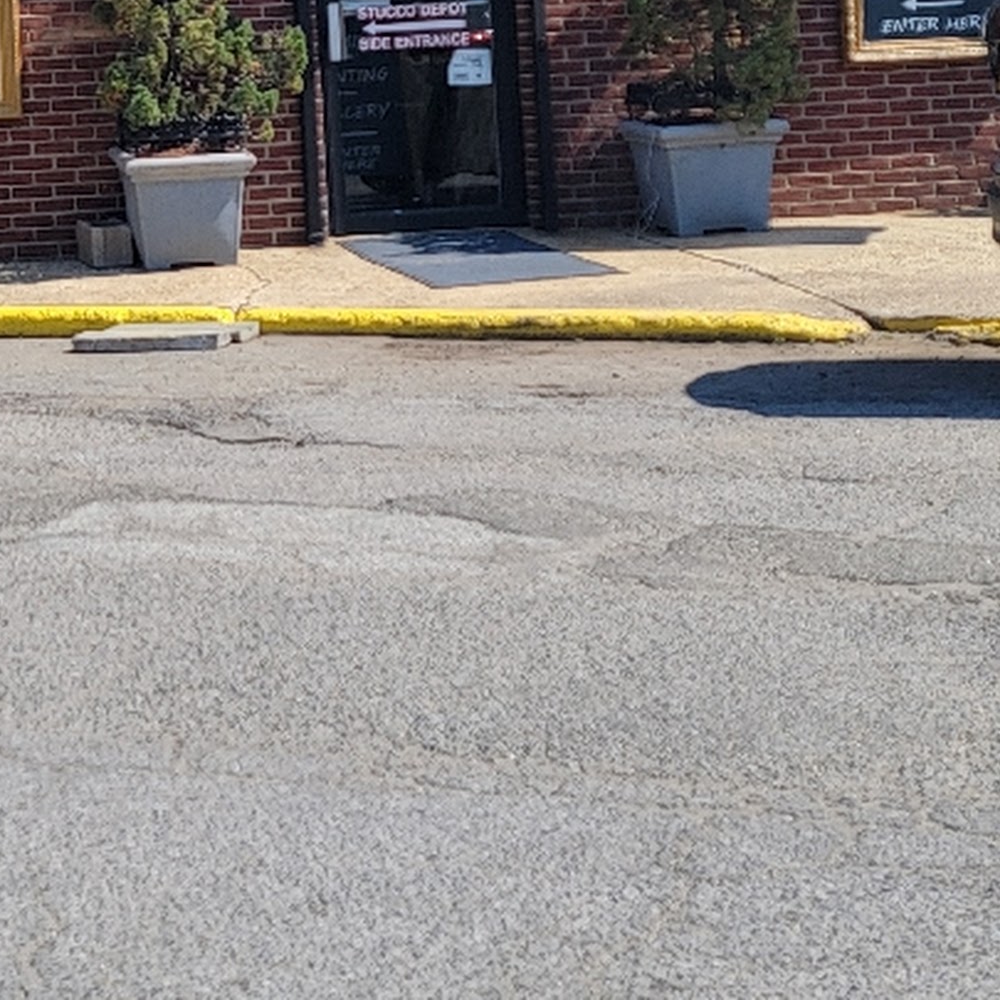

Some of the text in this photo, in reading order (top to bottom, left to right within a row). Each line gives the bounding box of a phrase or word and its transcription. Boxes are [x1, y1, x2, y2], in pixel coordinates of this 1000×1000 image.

[357, 2, 467, 20] STUCCO DEPOT
[879, 15, 986, 34] ENTER HER
[358, 32, 470, 51] SIDE ENTRANCE
